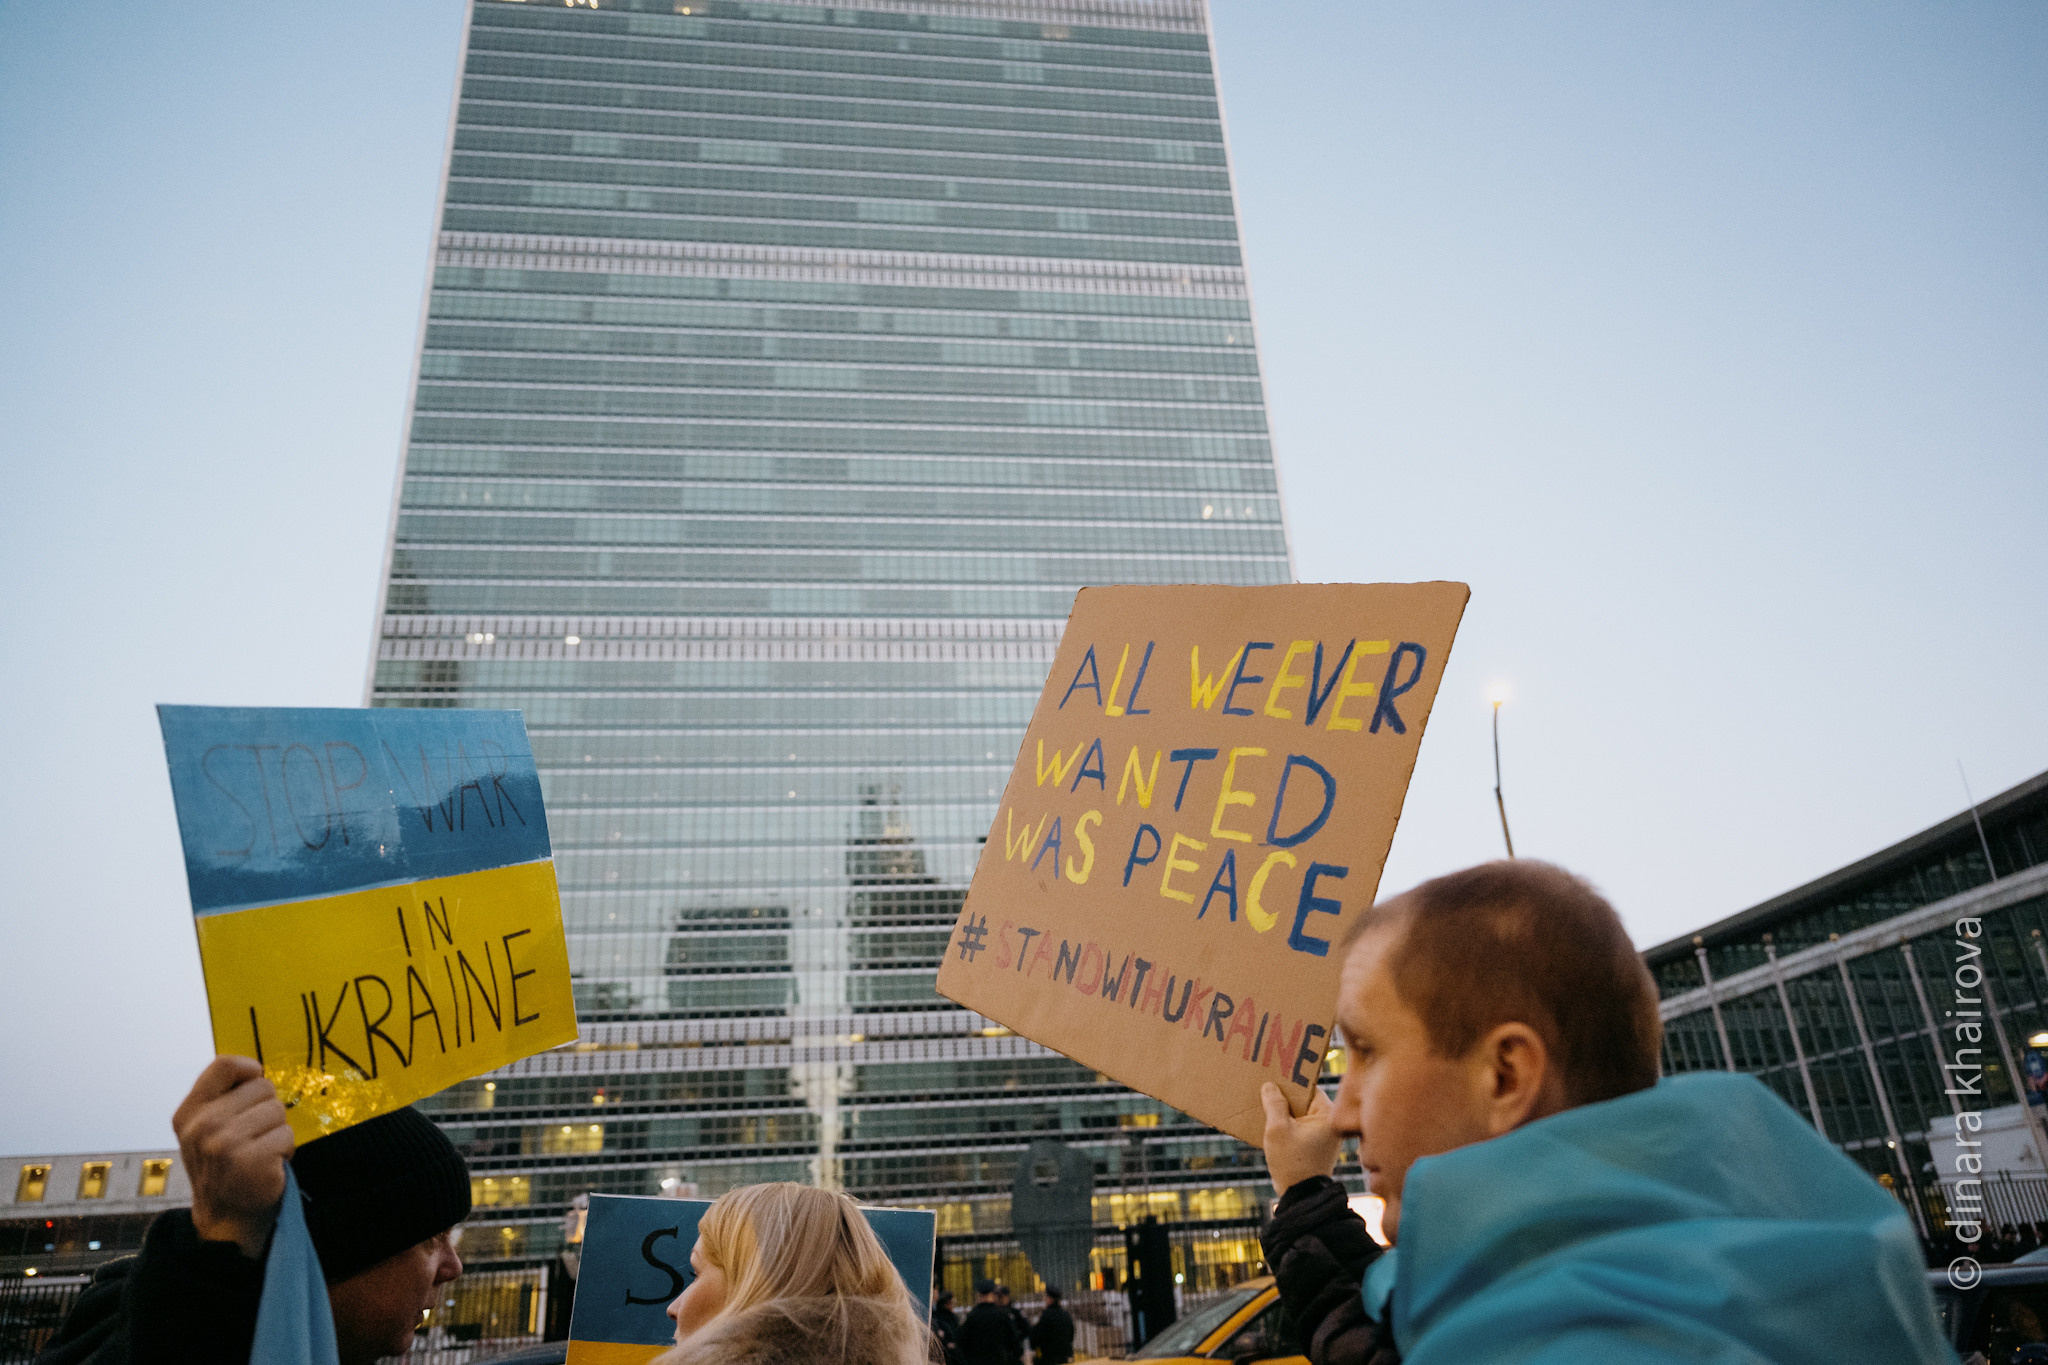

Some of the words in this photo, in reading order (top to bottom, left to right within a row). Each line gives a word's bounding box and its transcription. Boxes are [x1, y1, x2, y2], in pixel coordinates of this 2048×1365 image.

[1059, 640, 1155, 717] ALL
[203, 741, 368, 856] STOP
[381, 739, 527, 833] WAR
[1035, 738, 1337, 847] WANTED
[397, 896, 453, 958] IN
[1005, 807, 1102, 884] WAS
[1122, 822, 1349, 957] PEACE
[250, 928, 540, 1109] UKRAINE
